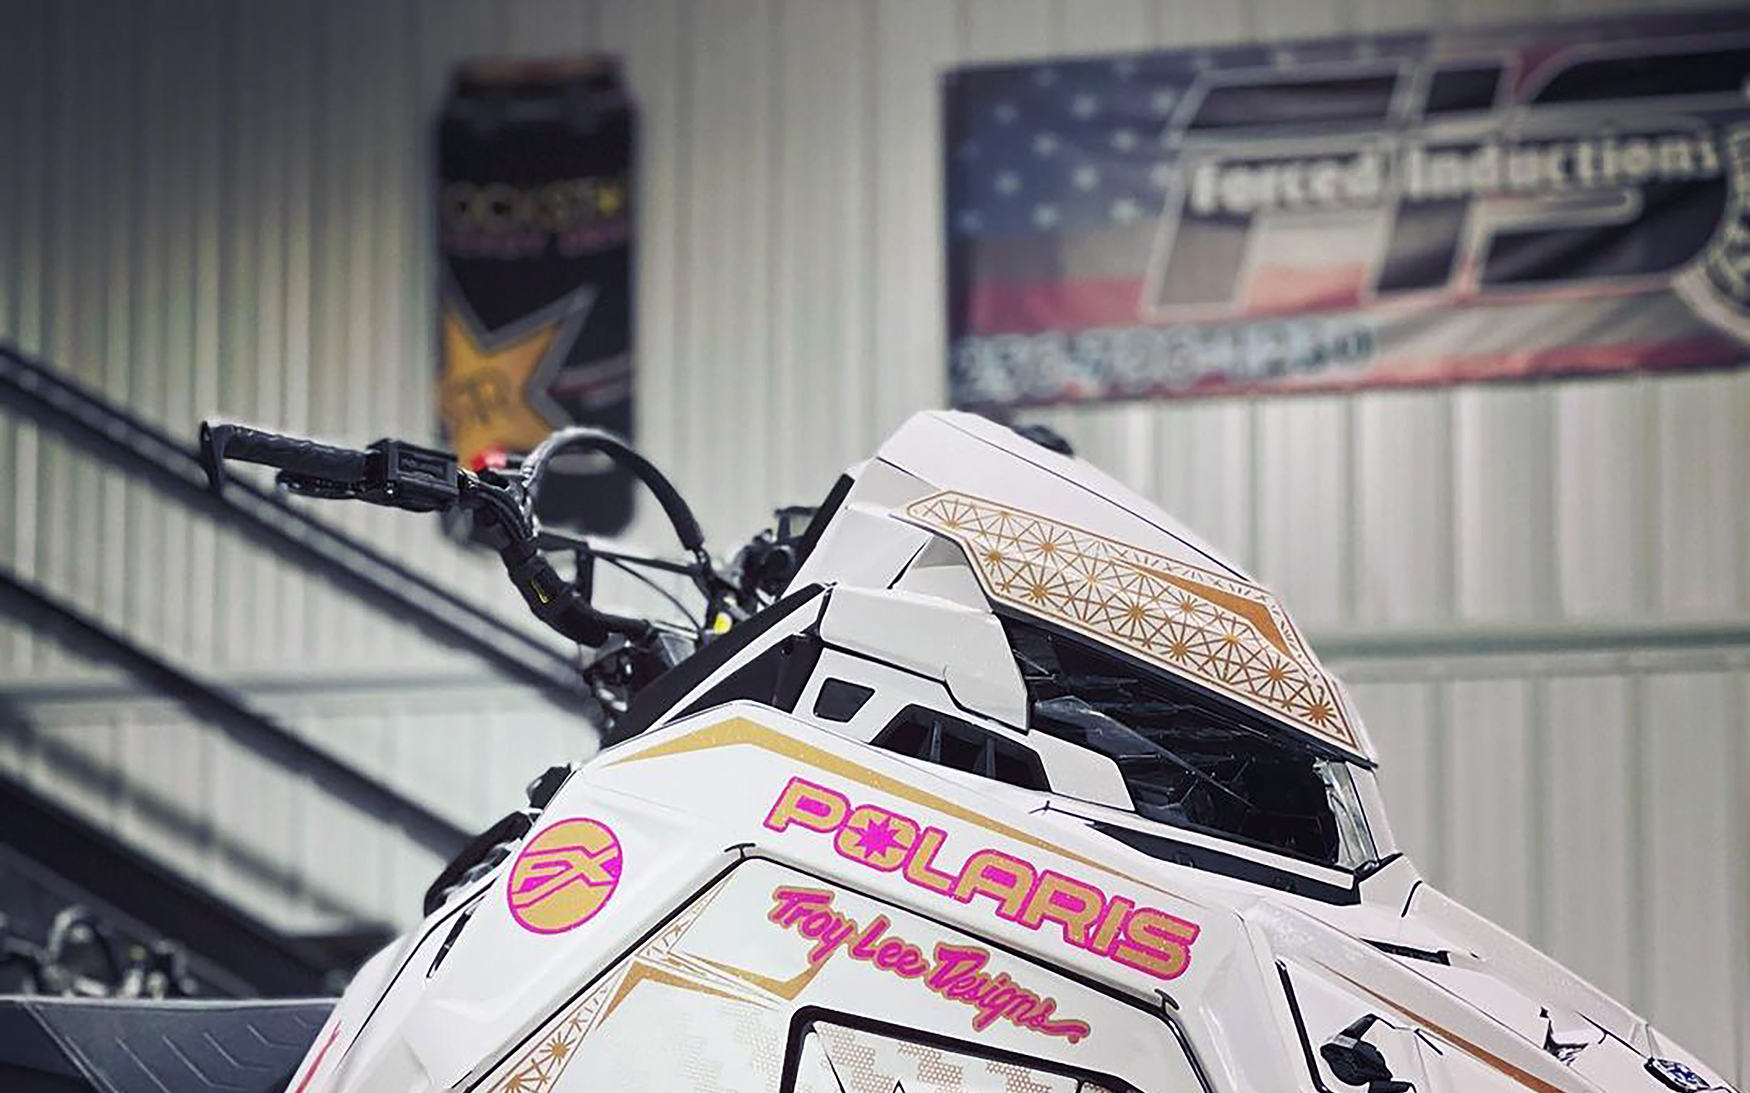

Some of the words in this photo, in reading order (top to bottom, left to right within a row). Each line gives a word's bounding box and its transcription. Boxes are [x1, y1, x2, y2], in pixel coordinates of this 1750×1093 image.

[763, 776, 1201, 981] POLARIS
[767, 886, 856, 966] Troy
[847, 914, 931, 979] Lee
[924, 941, 1091, 1044] Designs
